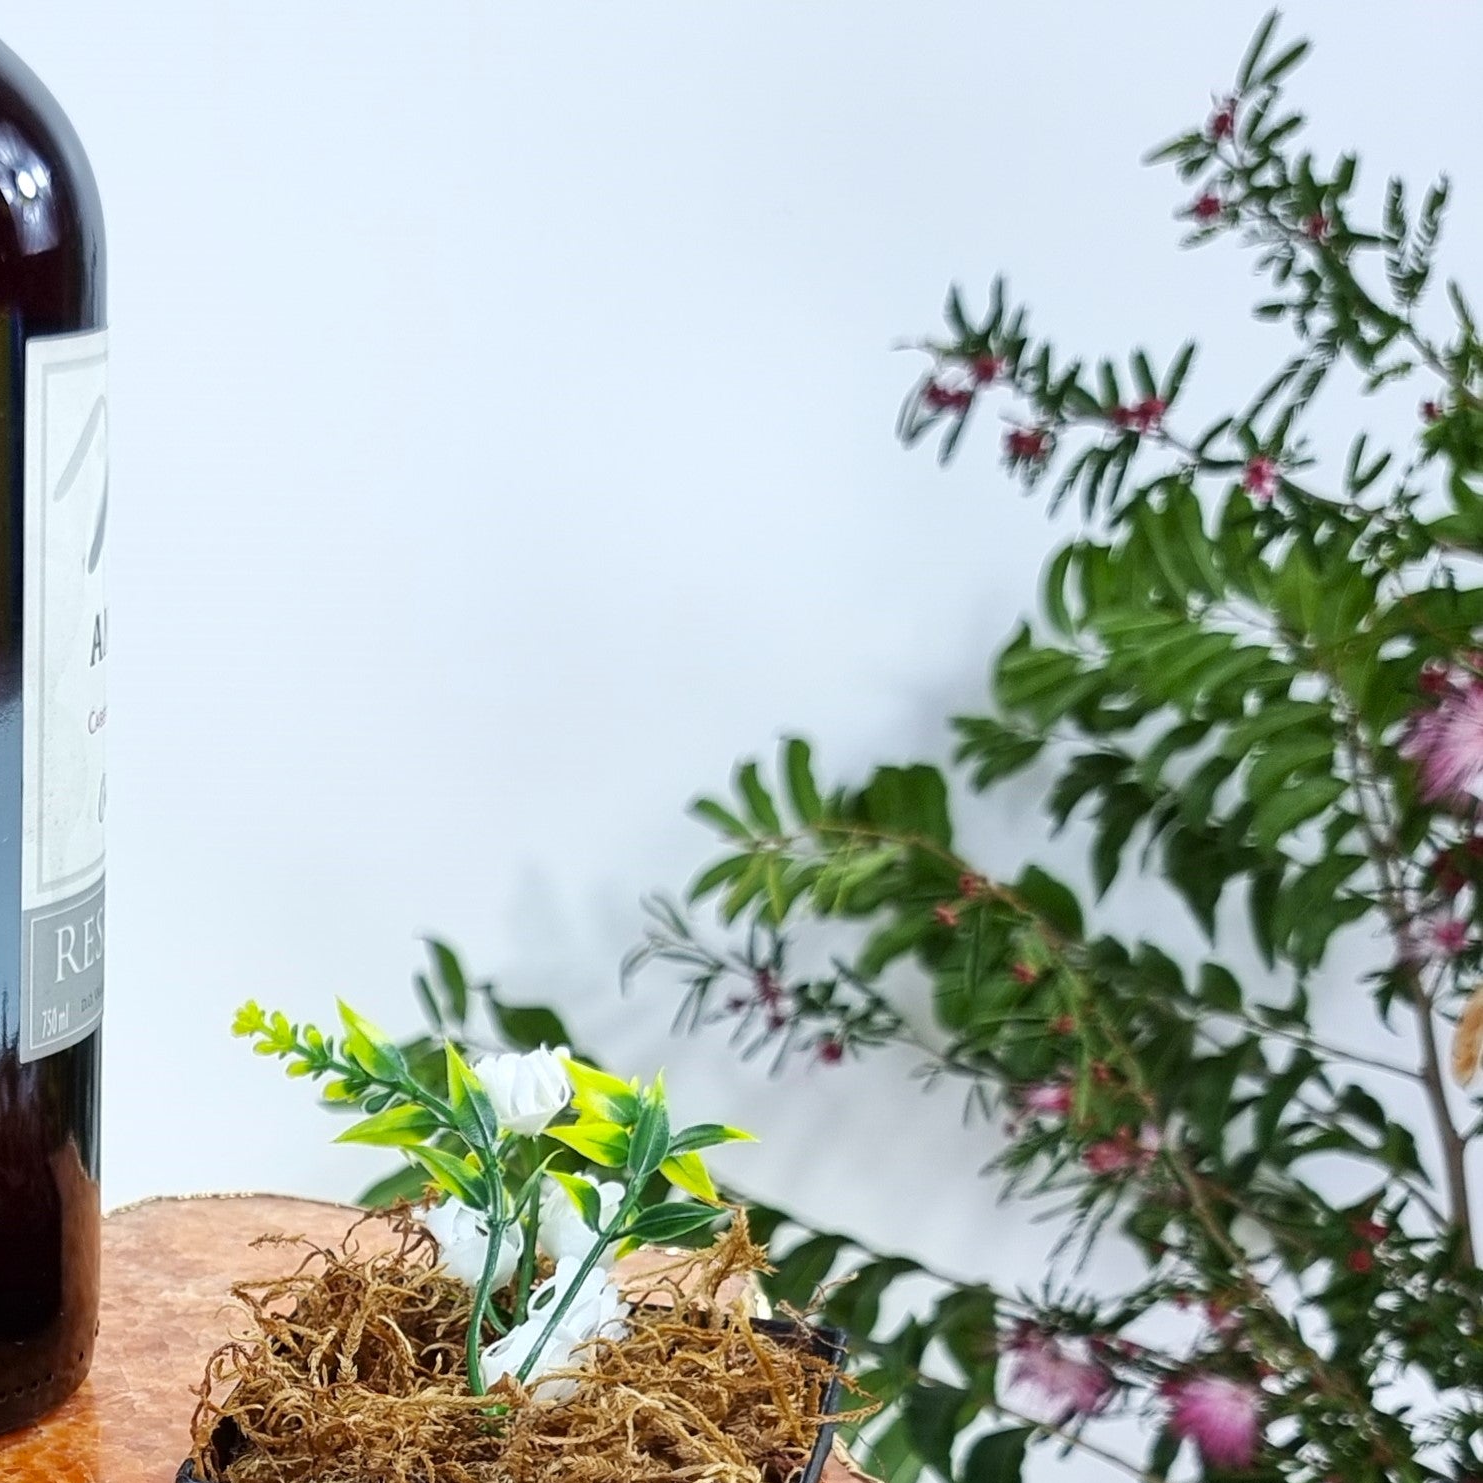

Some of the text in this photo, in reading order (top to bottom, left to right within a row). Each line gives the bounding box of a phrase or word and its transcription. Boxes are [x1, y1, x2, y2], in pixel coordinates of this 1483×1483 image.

[53, 906, 105, 984] RES
[41, 1002, 70, 1040] 750 ml
